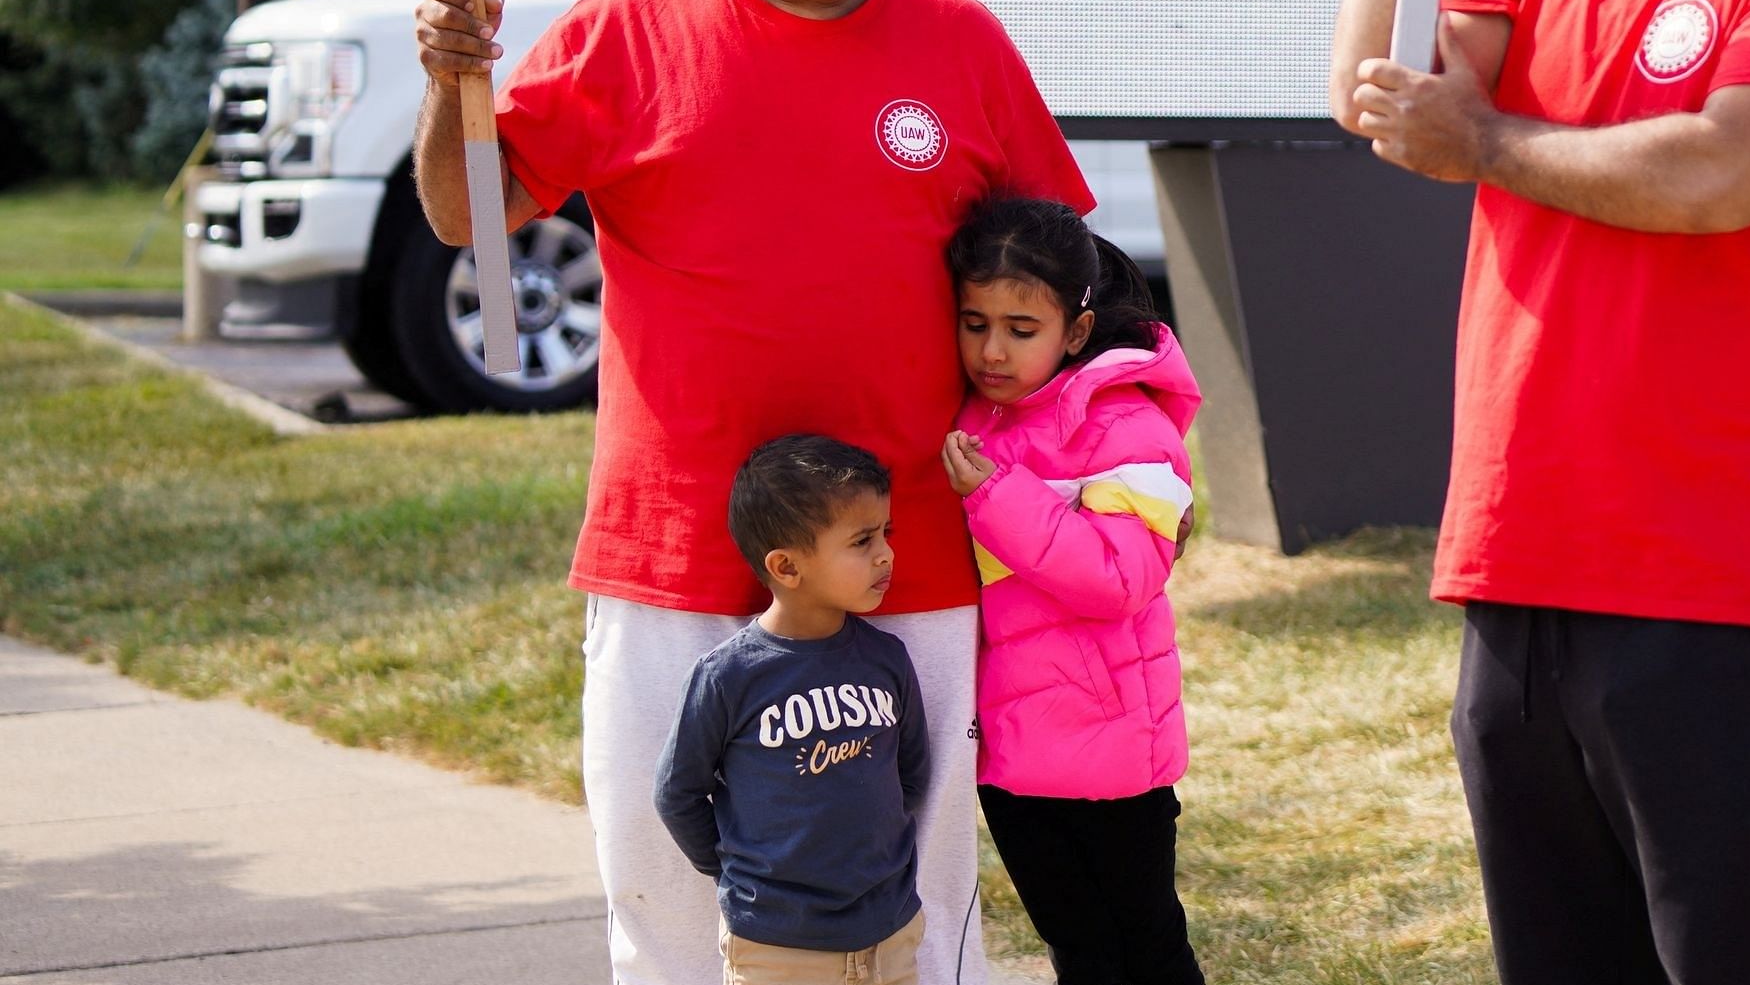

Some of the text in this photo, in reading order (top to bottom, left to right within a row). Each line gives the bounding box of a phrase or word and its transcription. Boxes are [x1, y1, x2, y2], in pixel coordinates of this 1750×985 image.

[900, 125, 926, 141] UAW
[758, 683, 898, 748] COUSIN
[809, 734, 871, 775] Crew
